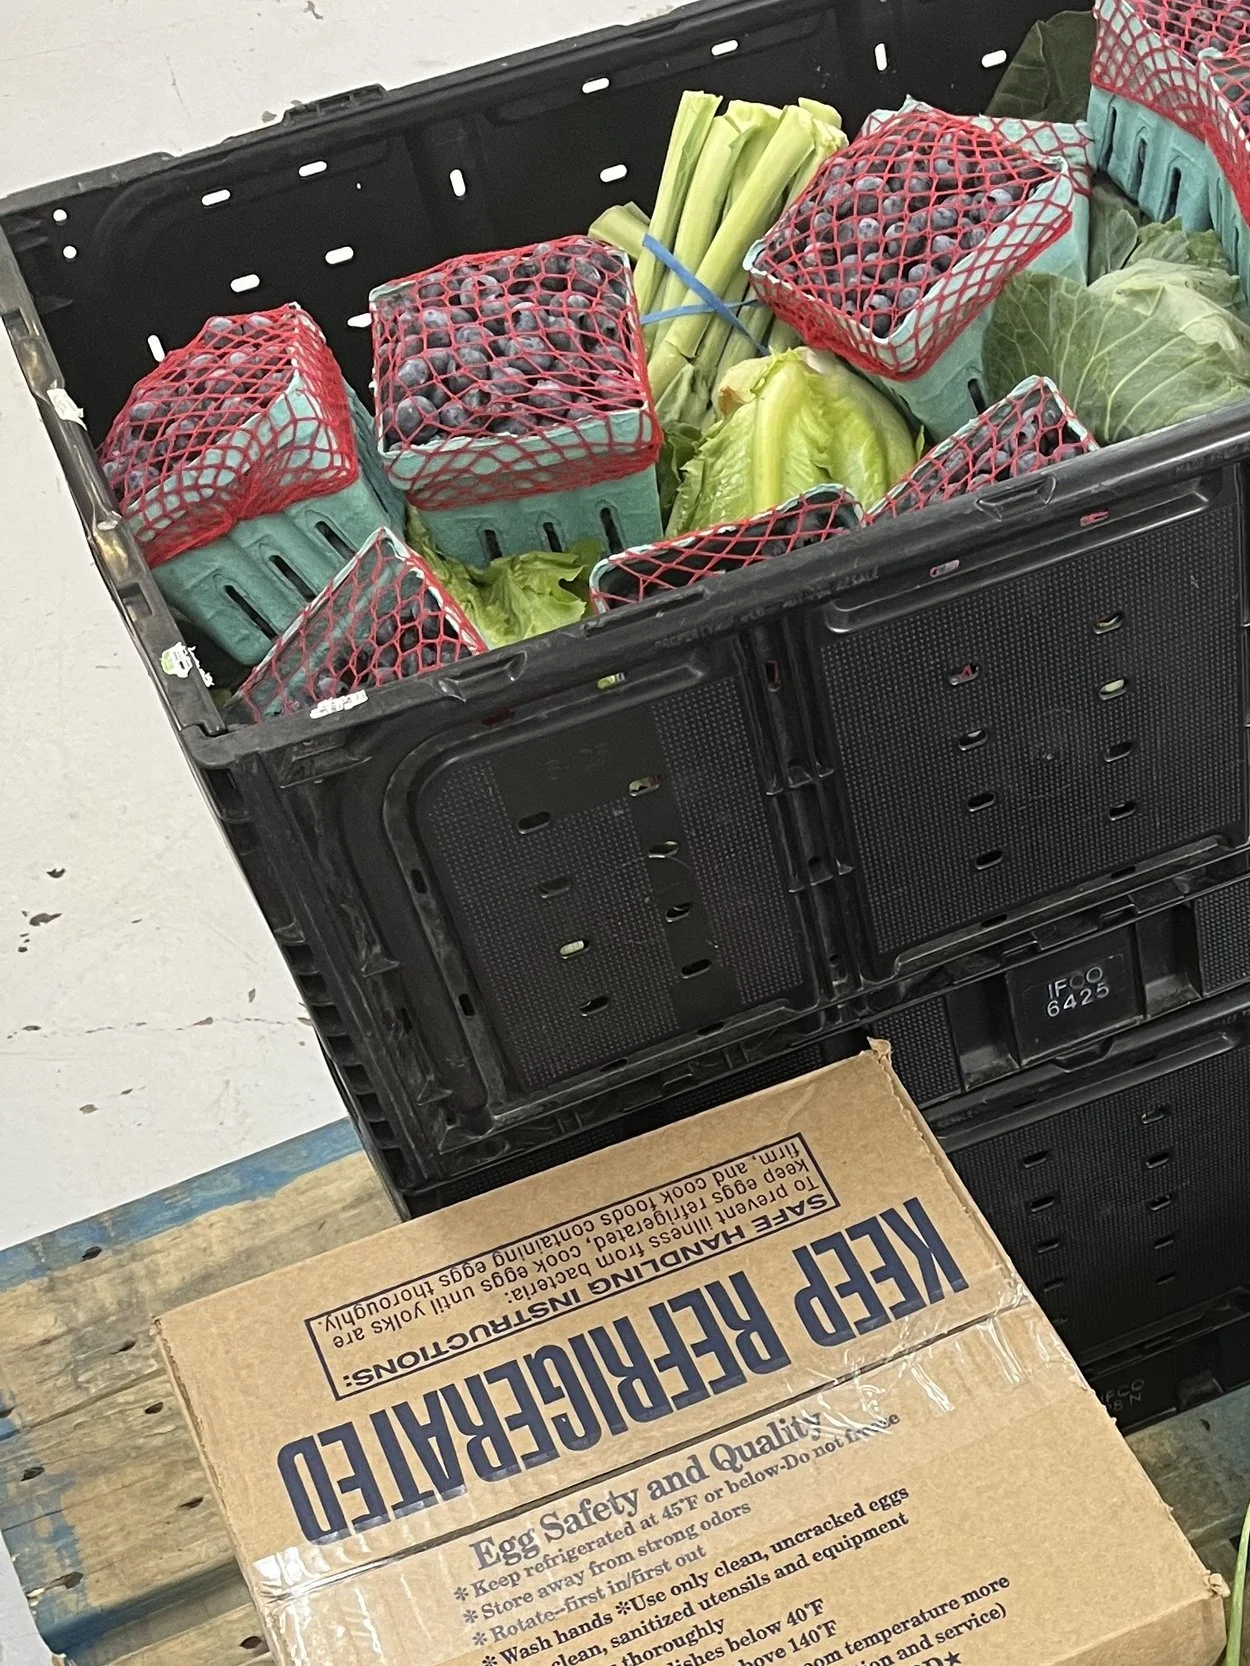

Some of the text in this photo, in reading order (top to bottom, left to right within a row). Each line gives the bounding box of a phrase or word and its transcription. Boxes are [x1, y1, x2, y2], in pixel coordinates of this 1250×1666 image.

[1046, 983, 1110, 1018] 6425
[1048, 966, 1104, 1001] IFCO
[314, 1143, 799, 1332] firm, and cook foods containing eggs thoroughly.
[333, 1159, 808, 1348] keep eggs refrigerated, cook eggs until yolks are
[343, 1194, 827, 1387] SAFE HANDLING INSTRUCTIONS:
[505, 1176, 819, 1303] To prevent illness from bacteria:
[277, 1197, 969, 1545] KEEP REFRIGERATED
[469, 1412, 821, 1571] Egg Safety and Quality
[470, 1570, 521, 1598] Keep
[523, 1521, 637, 1577] refrigerated
[640, 1513, 659, 1530] at
[705, 1488, 723, 1503] or
[812, 1436, 844, 1458] not
[675, 1545, 706, 1567] out
[481, 1503, 751, 1620] Store away from strong odors
[499, 1488, 909, 1664] Wash hands Use only clean, uncracked eggs
[610, 1601, 696, 1648] sanitized
[698, 1574, 771, 1610] utensils
[774, 1554, 810, 1579] and
[813, 1512, 909, 1562] equipment
[845, 1599, 960, 1655] temperature
[961, 1577, 1010, 1605] more
[724, 1621, 781, 1652] below
[896, 1634, 934, 1660] and
[935, 1603, 1006, 1643] service)
